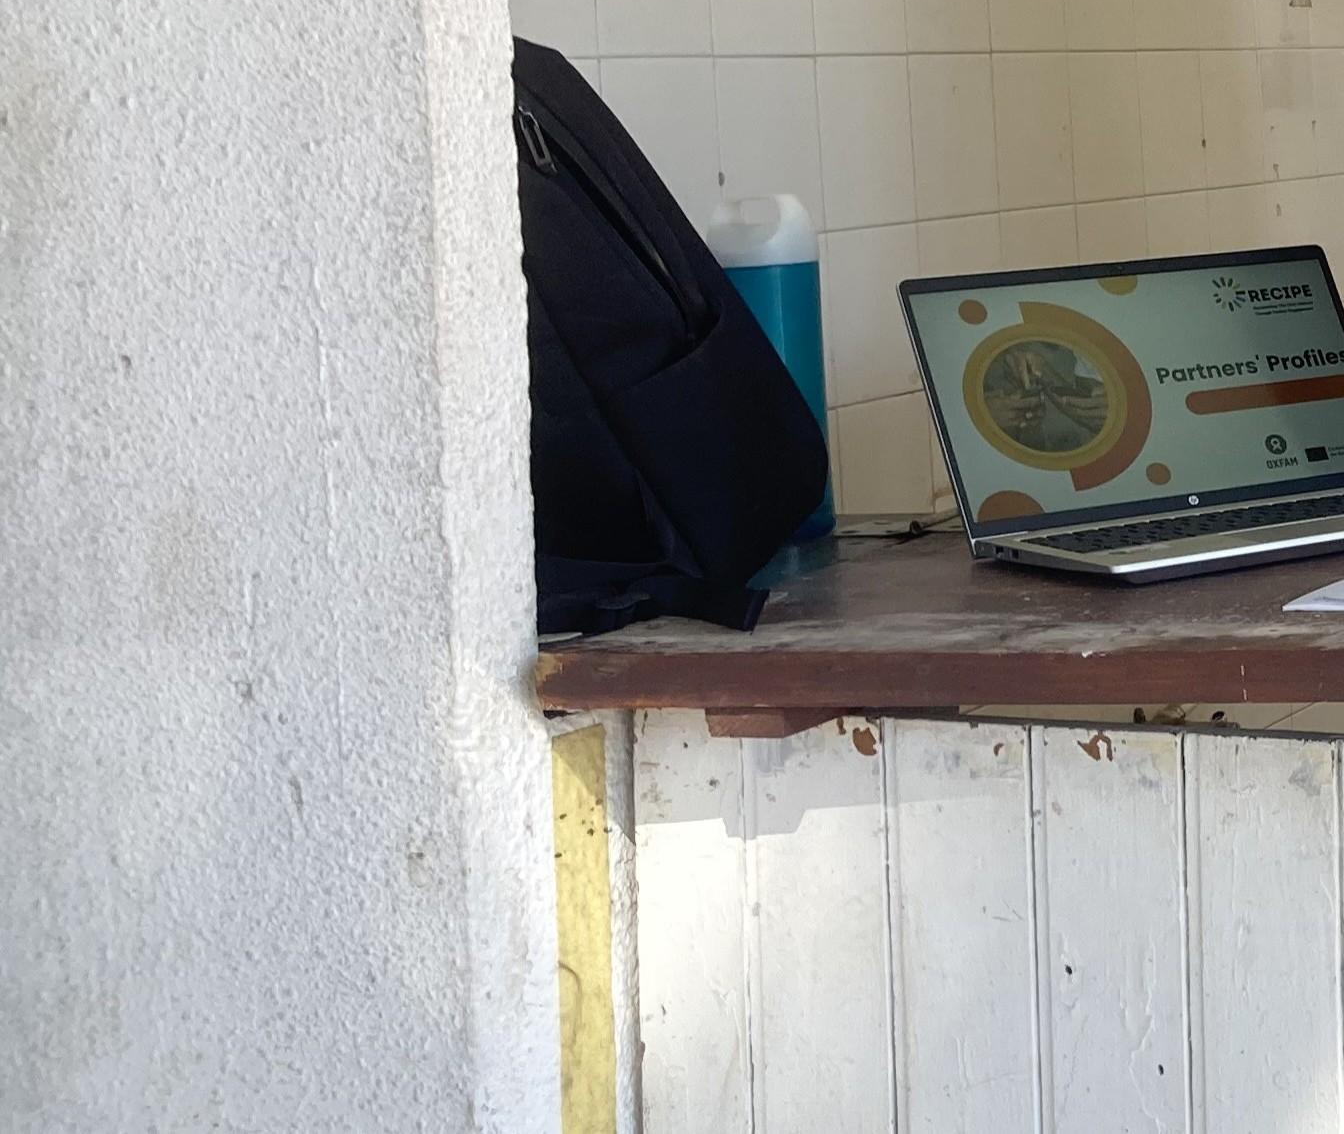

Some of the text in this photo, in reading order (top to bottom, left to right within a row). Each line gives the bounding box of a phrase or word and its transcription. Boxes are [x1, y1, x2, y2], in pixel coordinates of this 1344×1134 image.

[1247, 284, 1313, 303] RECIPE
[1155, 355, 1260, 384] Partners'
[1265, 456, 1299, 469] OXFAM
